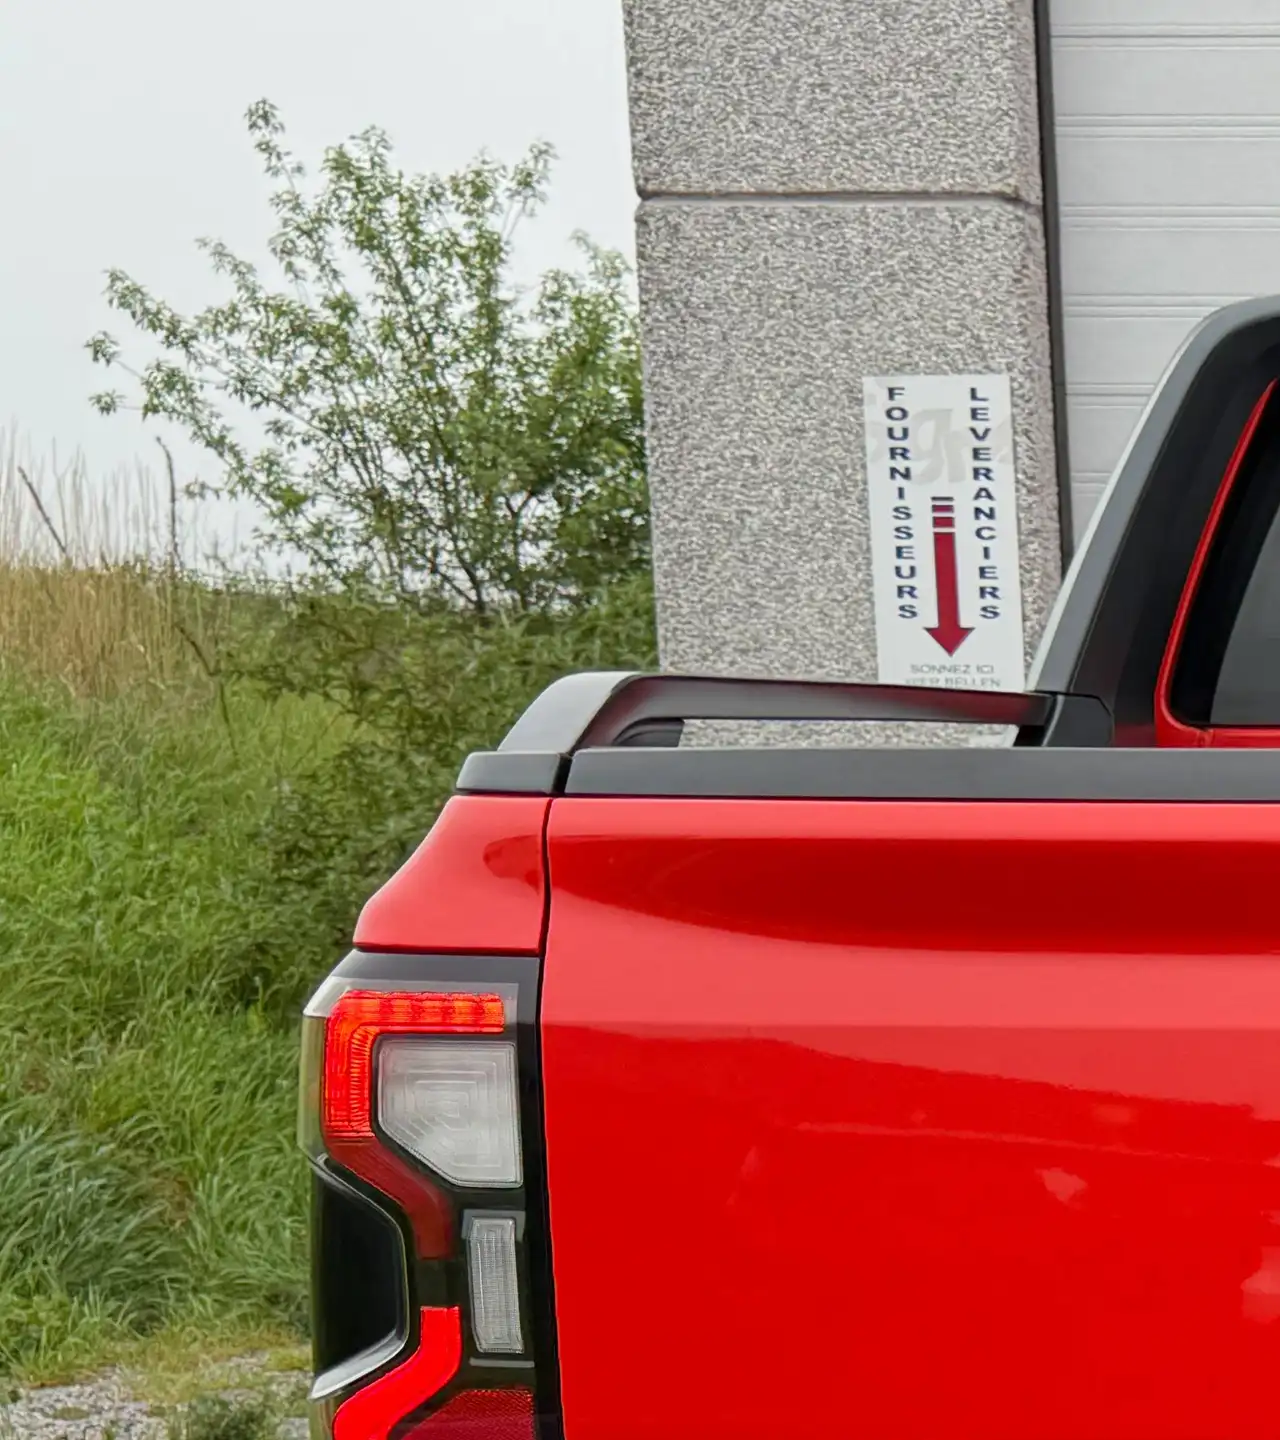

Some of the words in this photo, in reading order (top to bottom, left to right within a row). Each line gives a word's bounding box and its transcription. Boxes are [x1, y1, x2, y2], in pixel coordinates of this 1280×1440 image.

[886, 387, 918, 620] FOURNISSEURS
[969, 387, 1001, 620] LEVERANCIERS
[910, 663, 971, 674] SONNEZ
[976, 664, 995, 674] ICI
